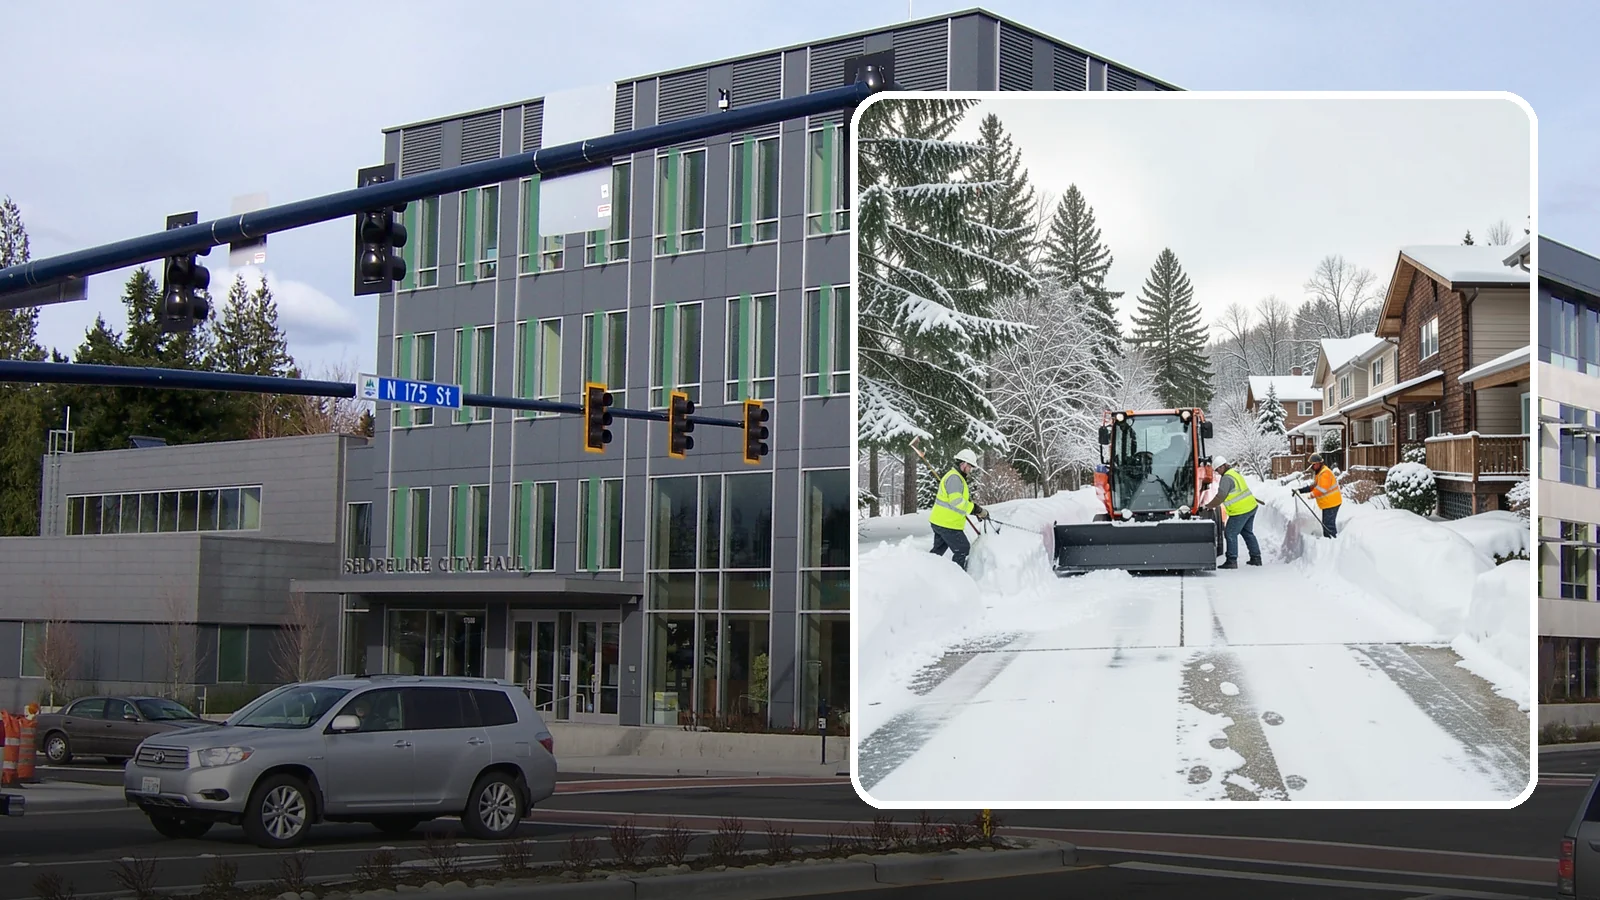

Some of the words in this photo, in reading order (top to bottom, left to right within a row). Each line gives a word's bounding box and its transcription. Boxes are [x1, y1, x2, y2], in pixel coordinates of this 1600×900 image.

[387, 380, 396, 400] N
[405, 382, 428, 403] 175
[436, 386, 451, 406] St
[343, 556, 432, 575] SHORELINE
[438, 556, 475, 573] CITY
[483, 555, 525, 572] HALL
